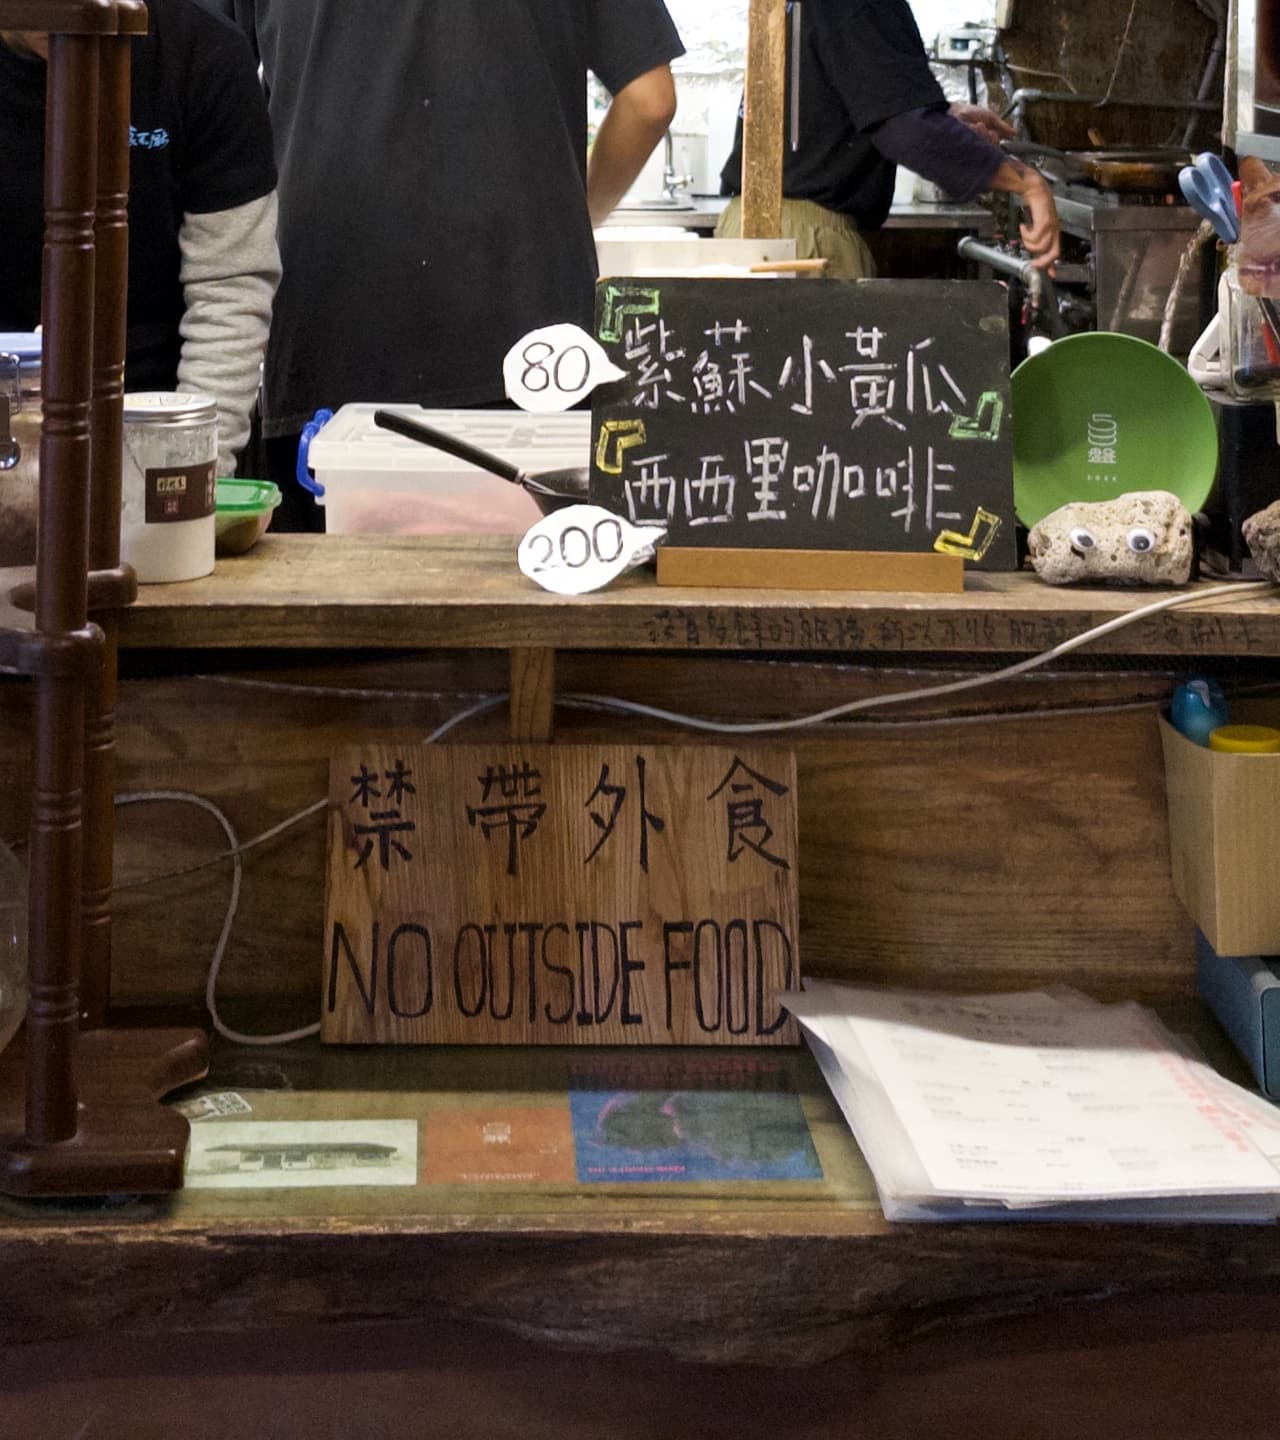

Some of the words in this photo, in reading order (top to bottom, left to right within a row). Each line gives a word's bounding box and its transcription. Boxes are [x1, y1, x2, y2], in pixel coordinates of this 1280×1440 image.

[521, 342, 590, 392] 80
[625, 317, 967, 430] 紫蘇小黃瓜
[625, 438, 962, 532] 西西里咖啡
[528, 519, 623, 572] 200
[350, 754, 790, 875] 禁帶外食
[328, 921, 433, 1018] NO
[453, 921, 644, 1027] OUTSIDE
[664, 919, 792, 1036] FOOD
